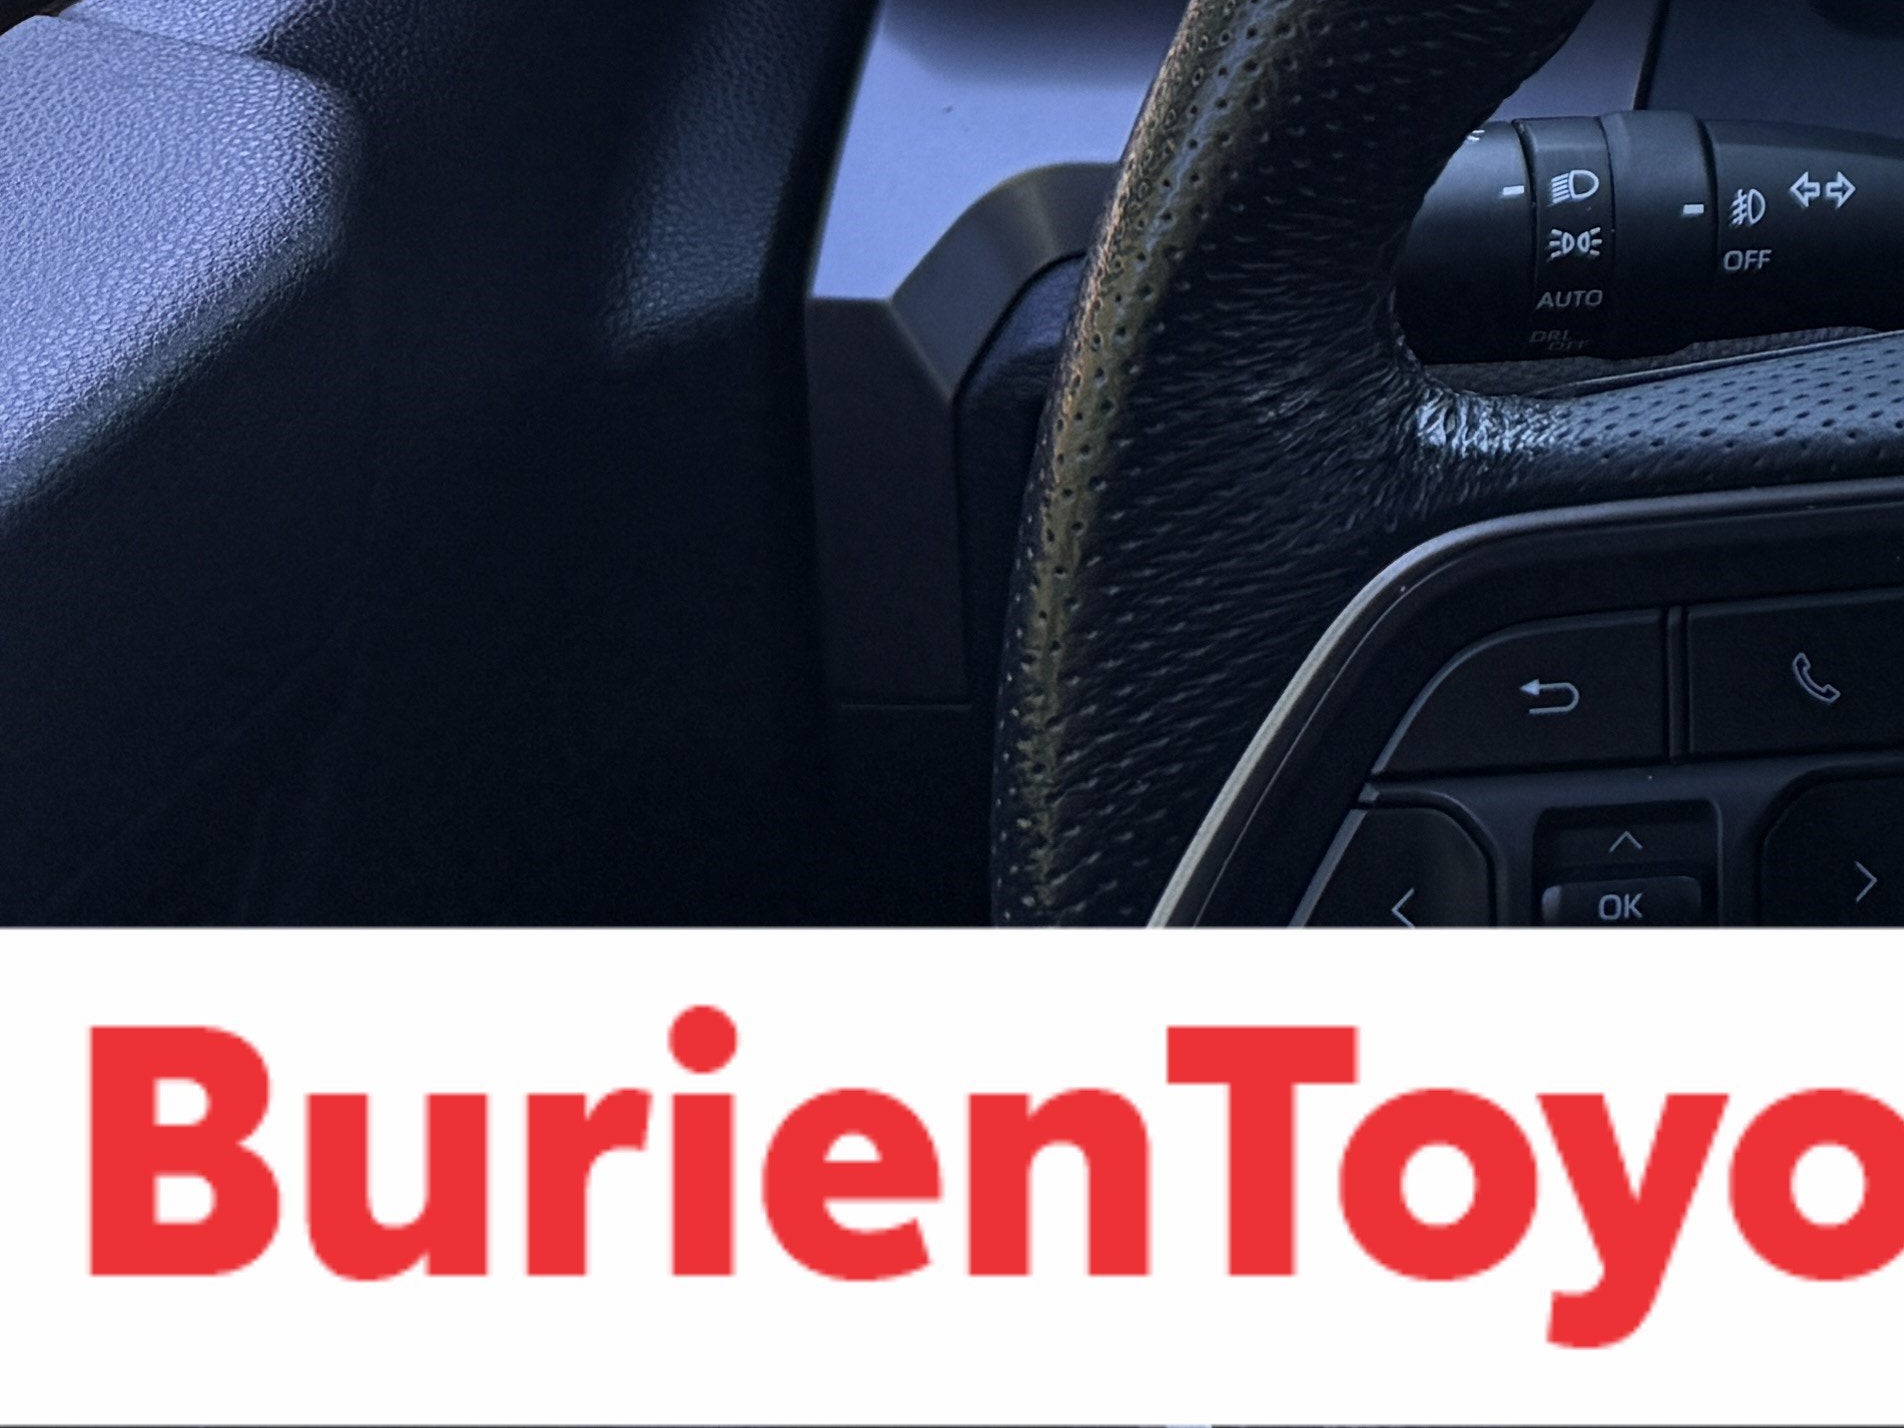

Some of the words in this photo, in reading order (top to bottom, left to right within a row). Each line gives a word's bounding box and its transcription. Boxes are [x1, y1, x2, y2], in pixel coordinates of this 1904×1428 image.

[1724, 250, 1771, 270] OFF
[1536, 290, 1602, 309] AUTO
[1599, 893, 1642, 920] OK
